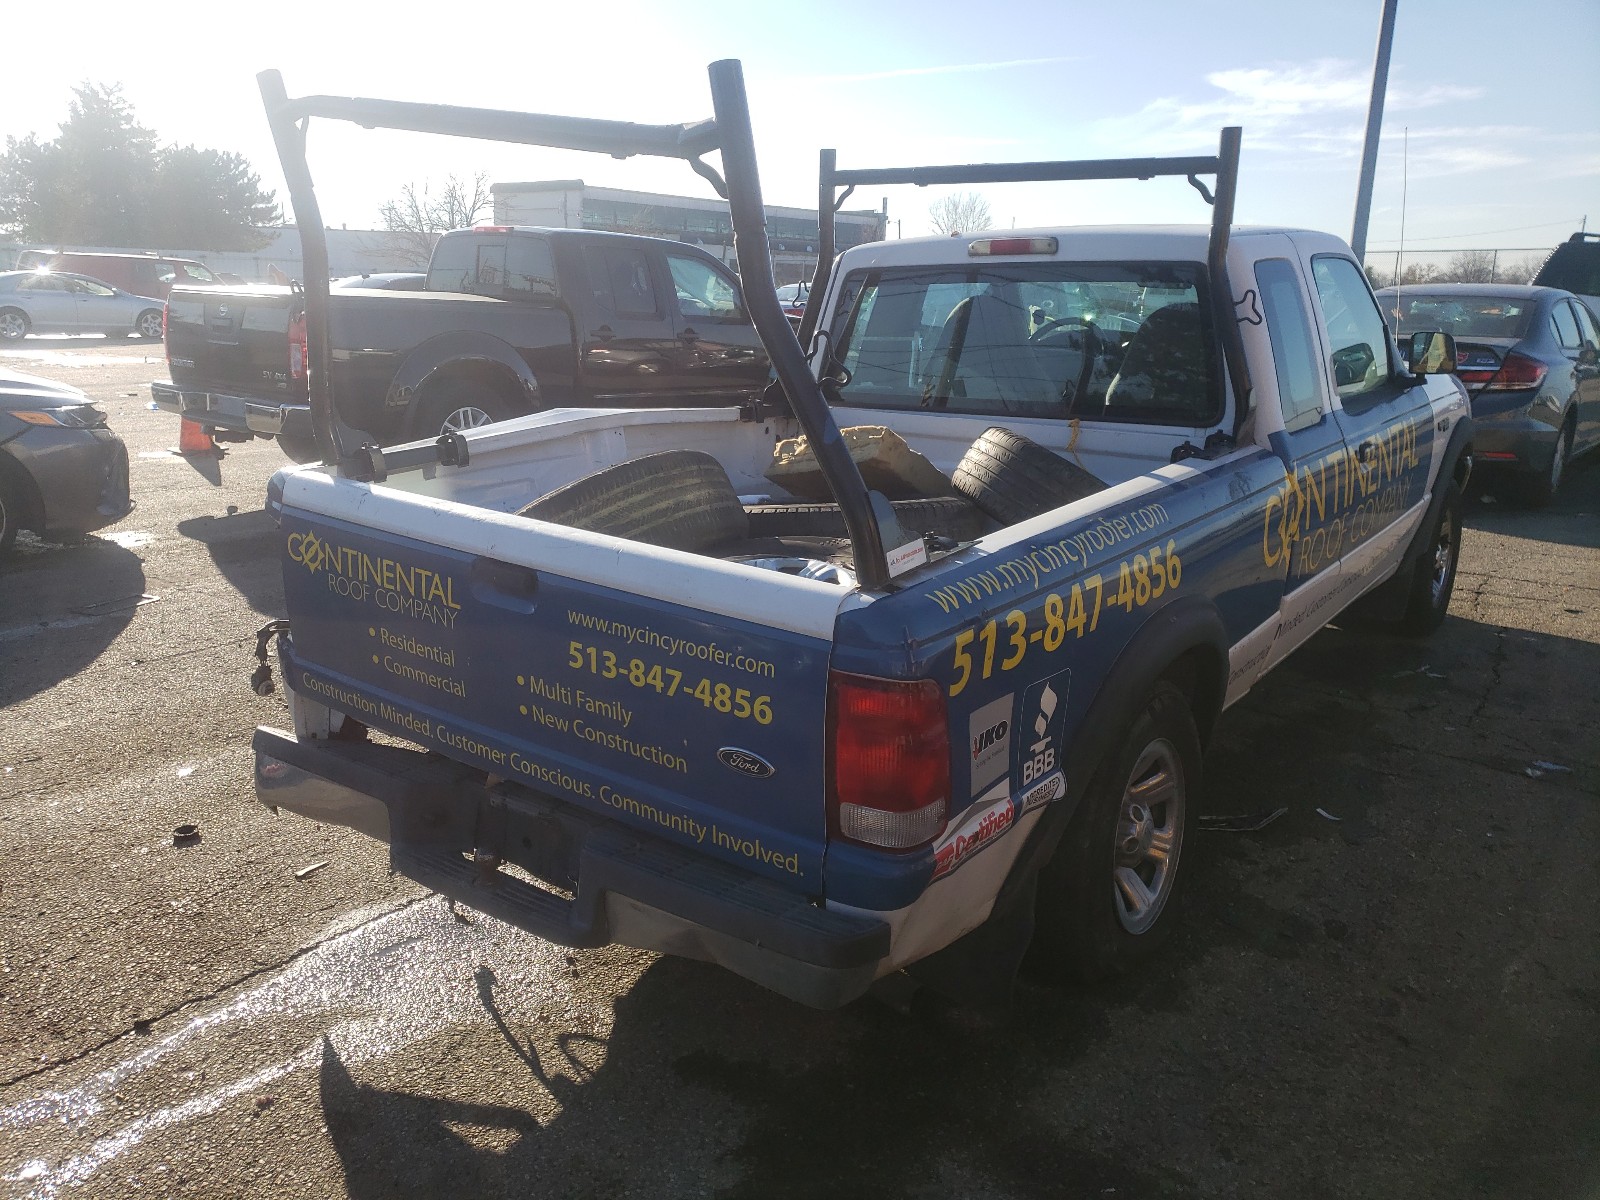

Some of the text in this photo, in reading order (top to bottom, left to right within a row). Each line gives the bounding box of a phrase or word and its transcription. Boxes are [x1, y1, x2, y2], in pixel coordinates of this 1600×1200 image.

[1264, 417, 1418, 574] CONTINENTAL
[1298, 512, 1349, 578] ROOF
[1351, 474, 1414, 543] COMPANY
[288, 531, 461, 609] CONTINENTAL
[925, 503, 1169, 613] www.mycincyroofer.com
[328, 573, 458, 629] ROOF COMPANY
[949, 539, 1182, 696] 513-847-4856
[380, 627, 455, 667] Residential
[384, 656, 466, 697] Commercial
[568, 609, 775, 678] www.mycincyroofer.com
[530, 675, 633, 728] Multi Family
[568, 641, 774, 725] 513-847-4856
[532, 704, 688, 773] New Construction
[729, 753, 760, 774] Ford
[1023, 748, 1055, 786] BBB
[302, 672, 378, 716] Construction
[436, 725, 507, 765] Customer
[510, 752, 596, 799] Conscious.
[600, 785, 707, 843] Community
[713, 825, 804, 876] Involved.
